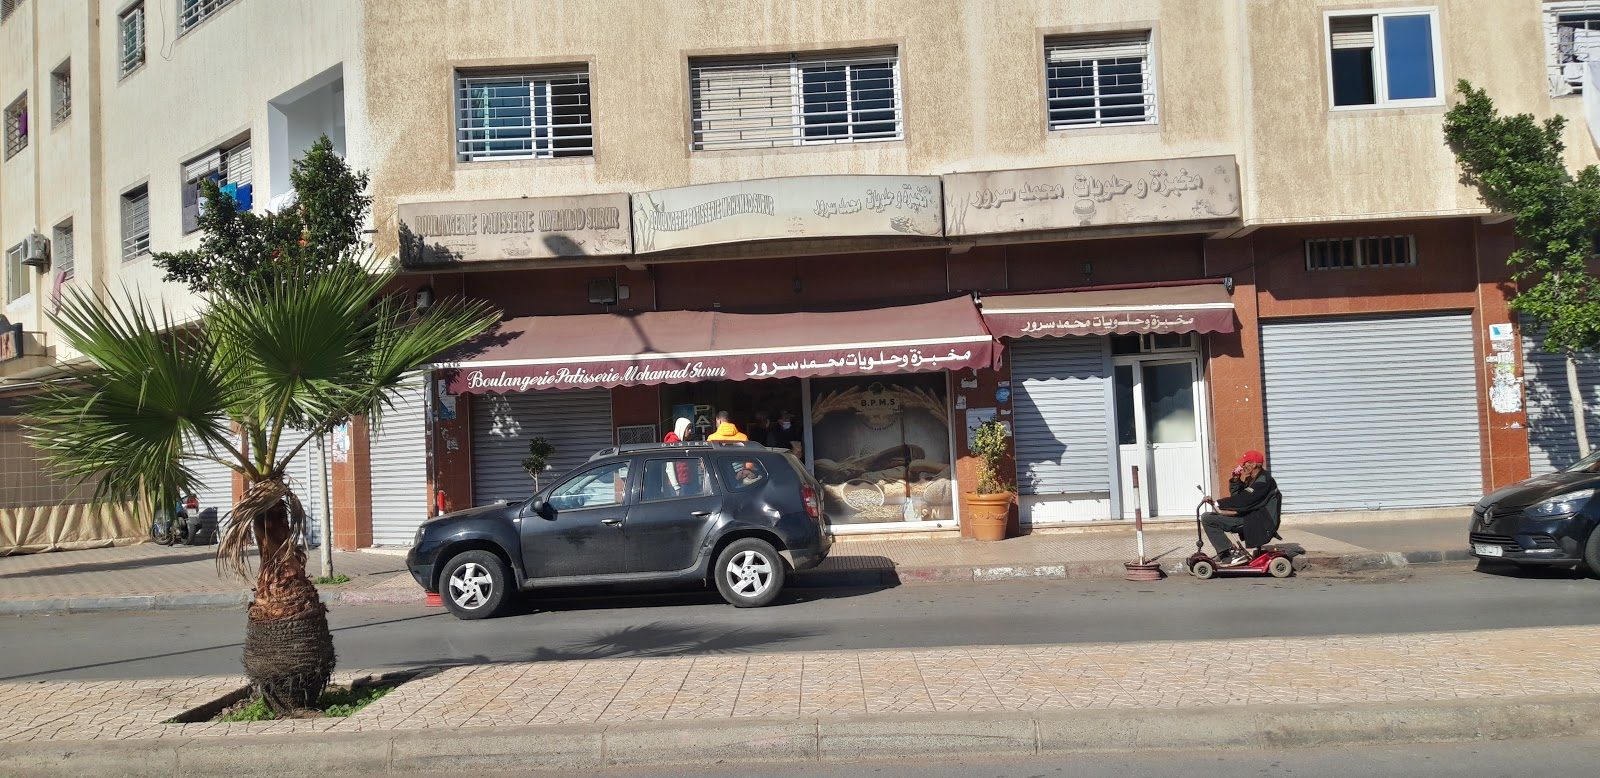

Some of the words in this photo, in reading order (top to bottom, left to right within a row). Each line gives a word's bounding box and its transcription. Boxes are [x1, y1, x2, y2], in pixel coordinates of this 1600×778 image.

[1017, 181, 1065, 200] محمد
[1072, 174, 1133, 202] حلويات
[1149, 168, 1204, 198] مخبزة
[970, 187, 1016, 209] سرور
[480, 210, 535, 235] PATISSERIE
[586, 206, 620, 230] SURUR
[466, 369, 556, 392] Boulangerie
[555, 366, 620, 384] Patisserie
[619, 362, 692, 382] Mohamad
[691, 360, 727, 379] Surur
